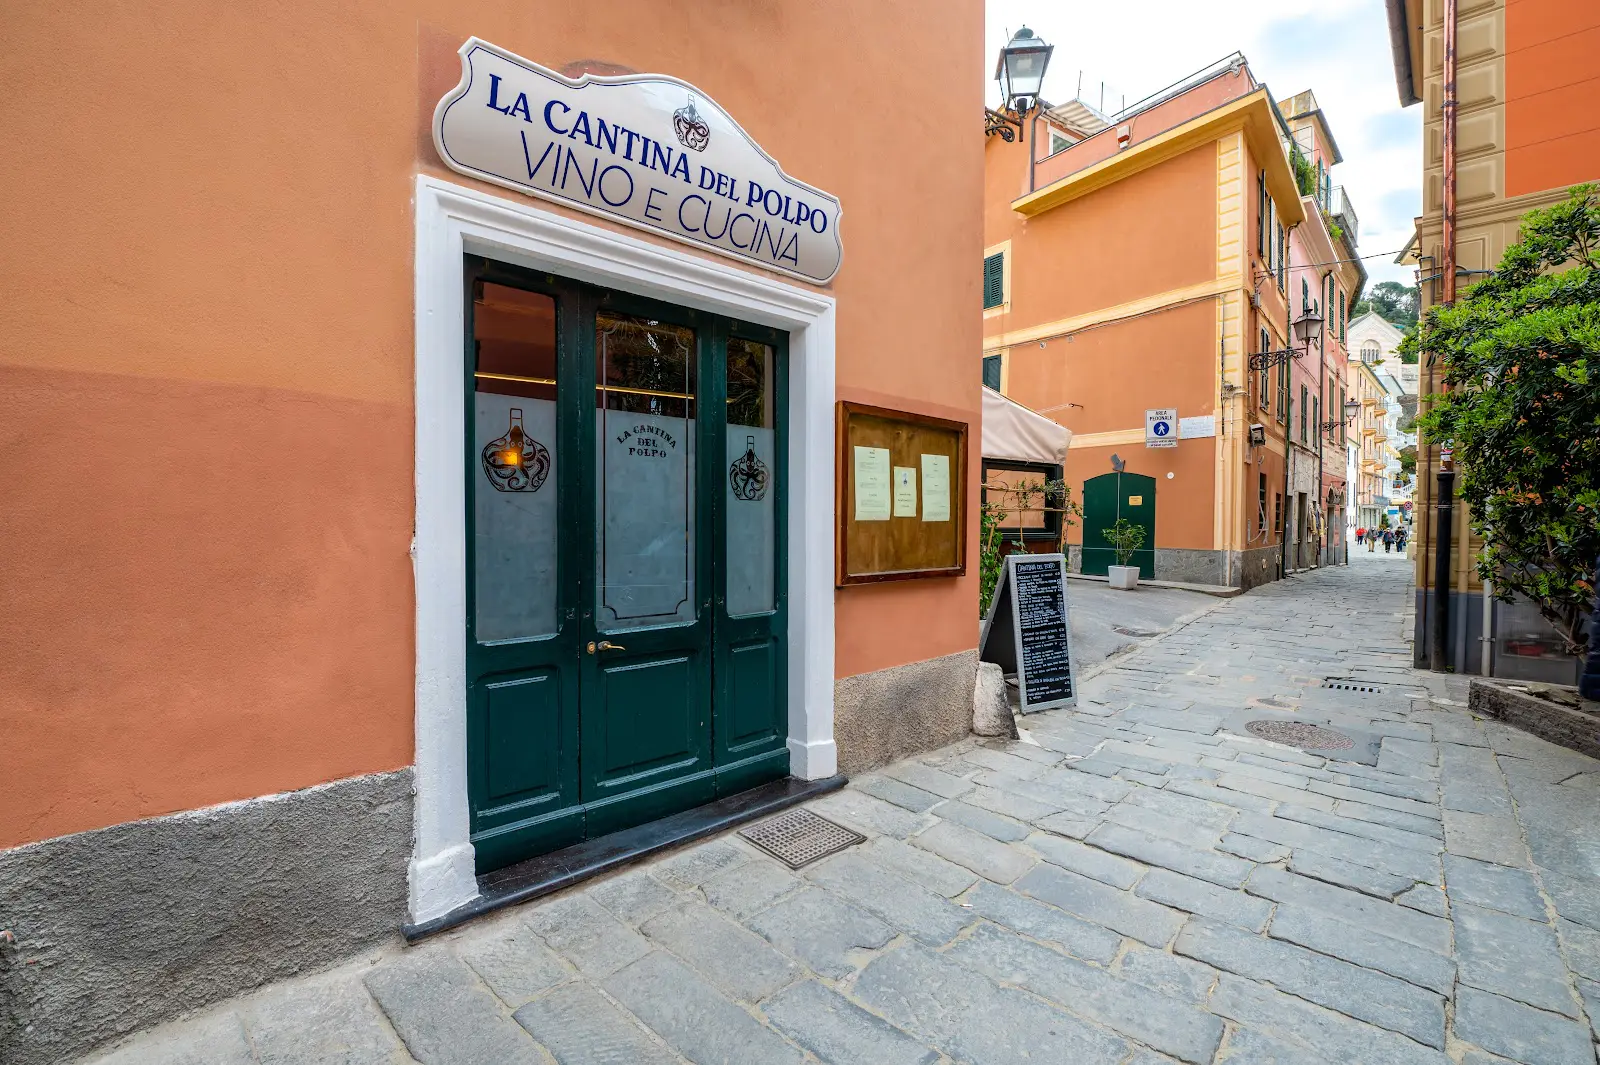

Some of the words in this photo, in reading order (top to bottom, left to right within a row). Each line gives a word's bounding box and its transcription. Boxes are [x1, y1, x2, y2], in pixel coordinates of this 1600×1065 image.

[486, 74, 532, 123] LA
[543, 100, 691, 183] CANTINA
[699, 165, 740, 202] DEL
[746, 180, 828, 234] POLPO
[521, 130, 634, 207] VINO
[645, 188, 668, 221] E
[678, 194, 799, 266] CUCINA
[616, 430, 632, 444] LA
[633, 424, 676, 449] CANTINA
[637, 437, 658, 448] DEL
[628, 447, 667, 458] POLPO
